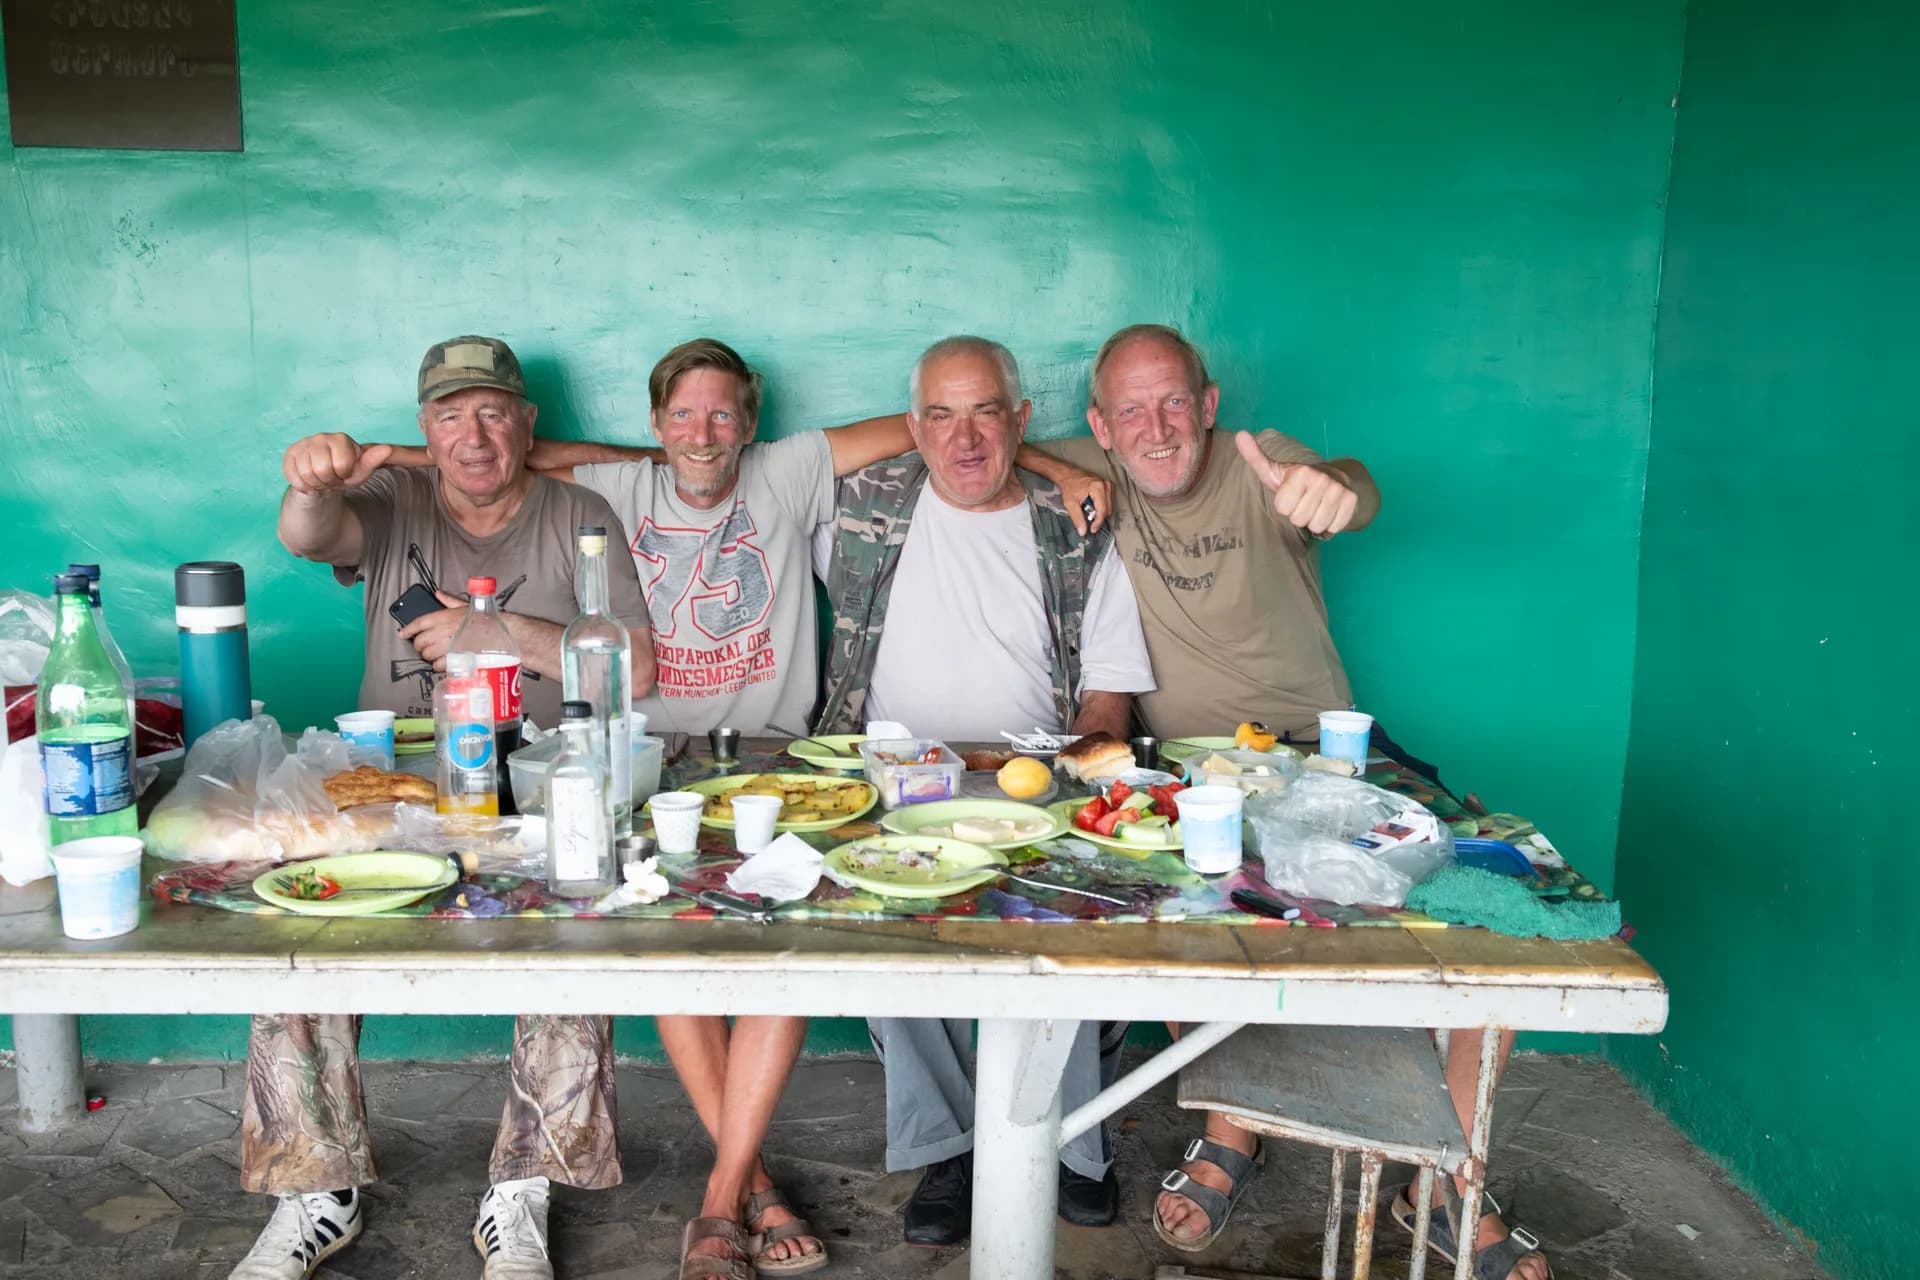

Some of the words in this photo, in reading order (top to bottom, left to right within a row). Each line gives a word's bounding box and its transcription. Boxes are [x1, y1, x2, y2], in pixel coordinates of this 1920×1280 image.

[631, 501, 776, 641] 75
[655, 640, 743, 665] UROPAPOKAL
[747, 627, 771, 652] DER
[656, 648, 775, 687] NDESMEISTER
[656, 684, 682, 698] YERN
[748, 669, 776, 685] UNITED
